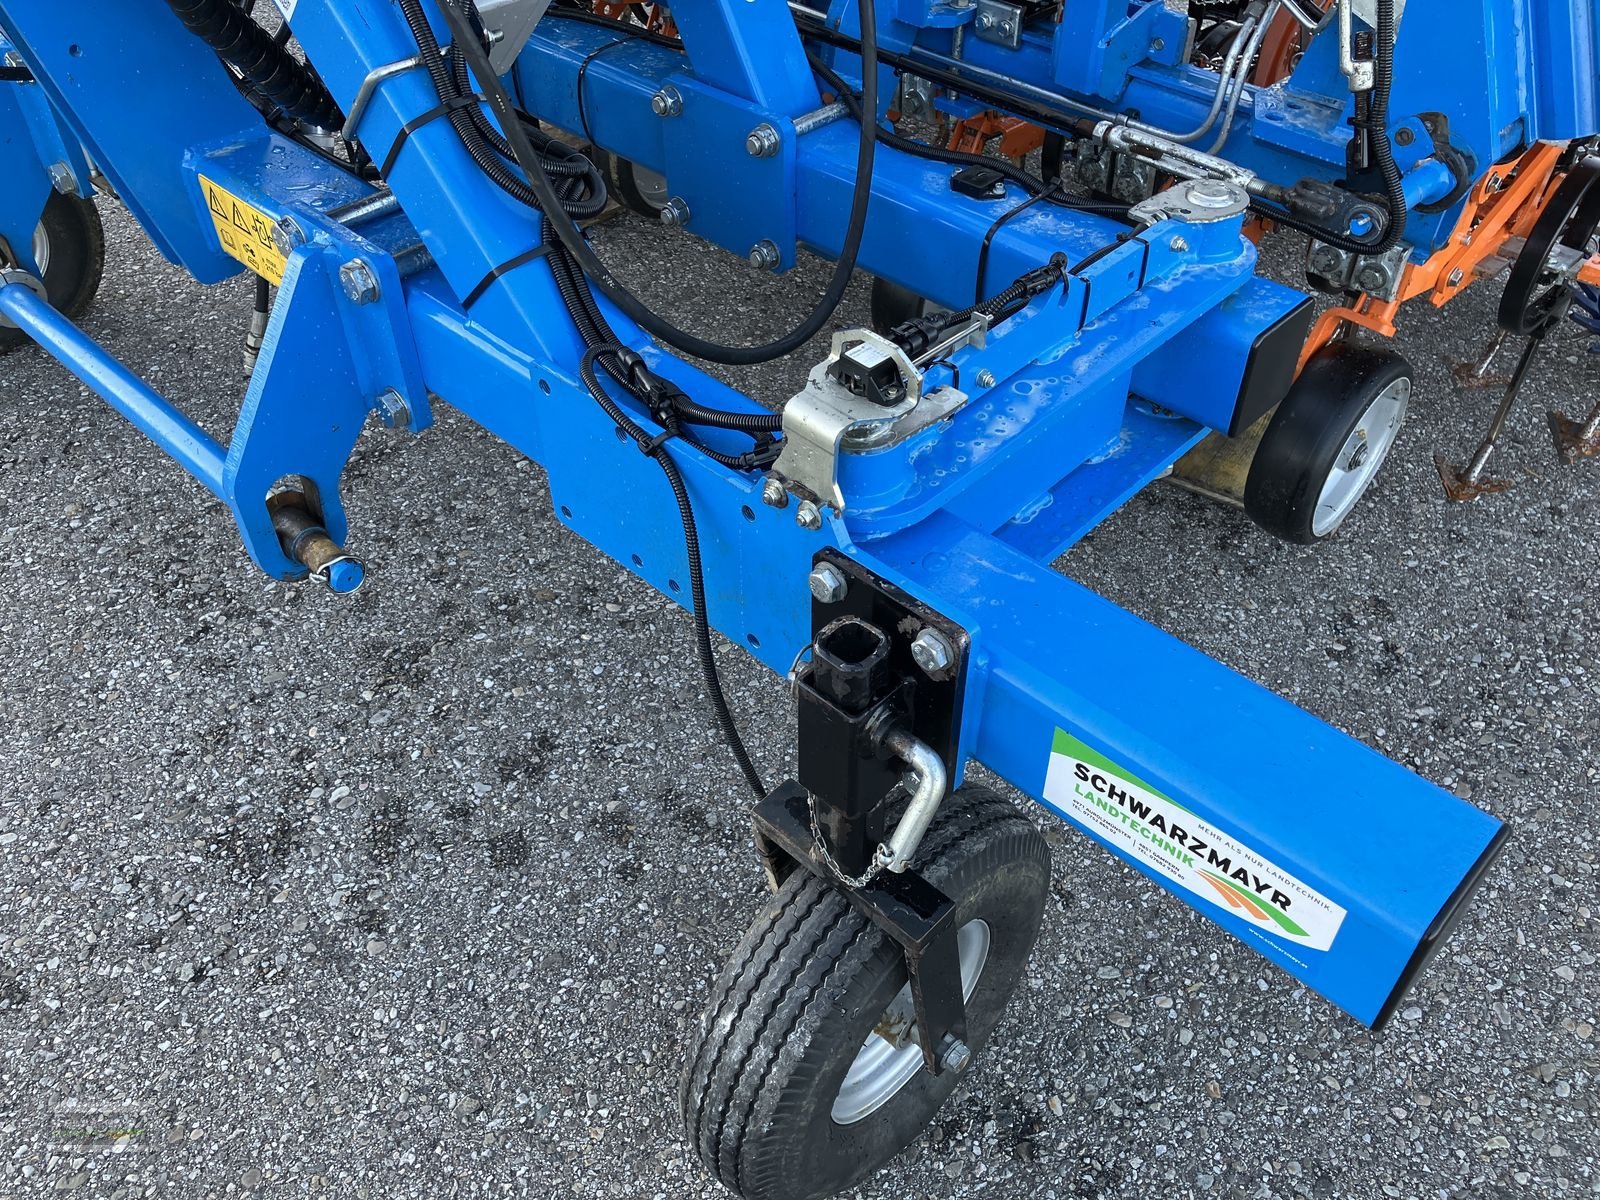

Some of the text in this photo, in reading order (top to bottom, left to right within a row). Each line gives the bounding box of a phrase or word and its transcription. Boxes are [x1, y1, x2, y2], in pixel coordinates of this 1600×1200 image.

[1073, 762, 1292, 912] SCHWARZMAYR
[1074, 782, 1195, 869] LANDTECHNIK
[1153, 852, 1180, 872] GAMPERN
[1198, 824, 1333, 913] MEHR ALS NUR LANDTECHNIK.
[1248, 927, 1308, 969] www.schwarzmayr.at
